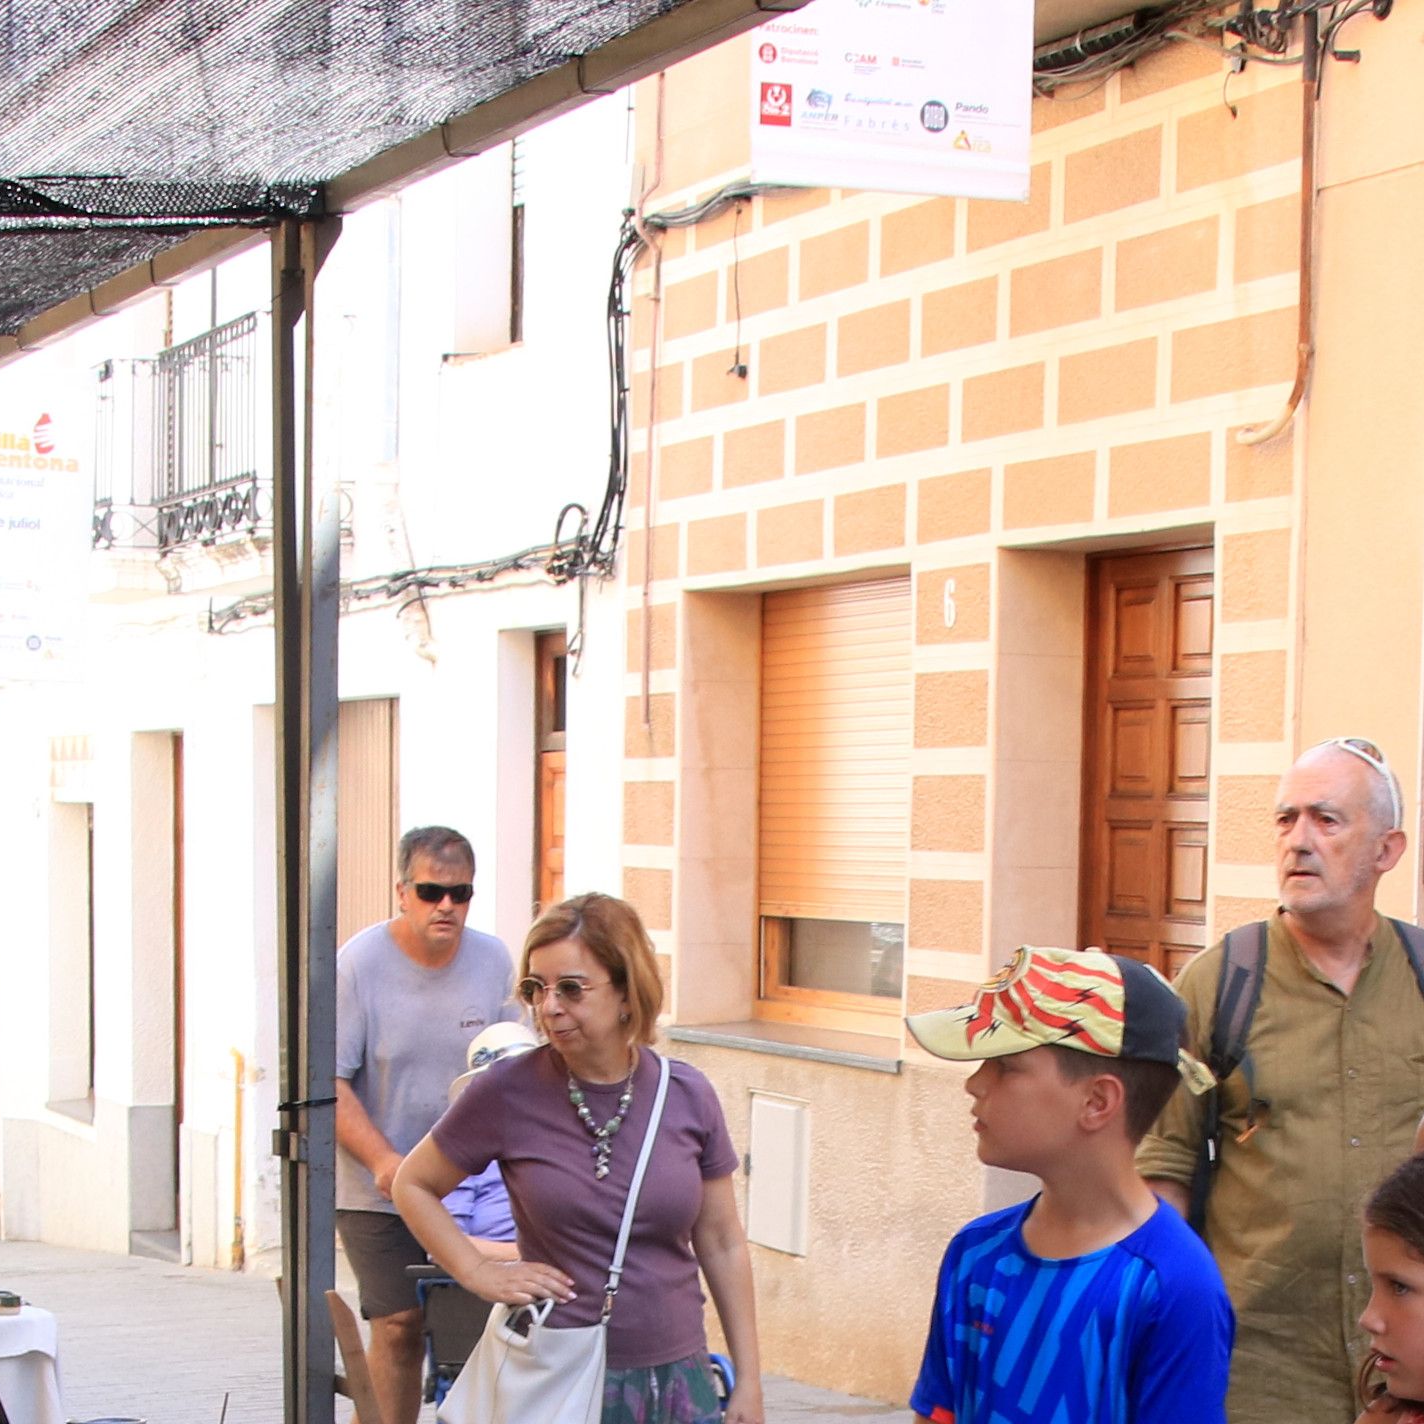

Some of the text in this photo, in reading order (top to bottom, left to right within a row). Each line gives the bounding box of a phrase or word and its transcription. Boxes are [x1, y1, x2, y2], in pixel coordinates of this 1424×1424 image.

[955, 101, 990, 115] Pando
[8, 516, 42, 531] juliol
[943, 577, 956, 629] 6
